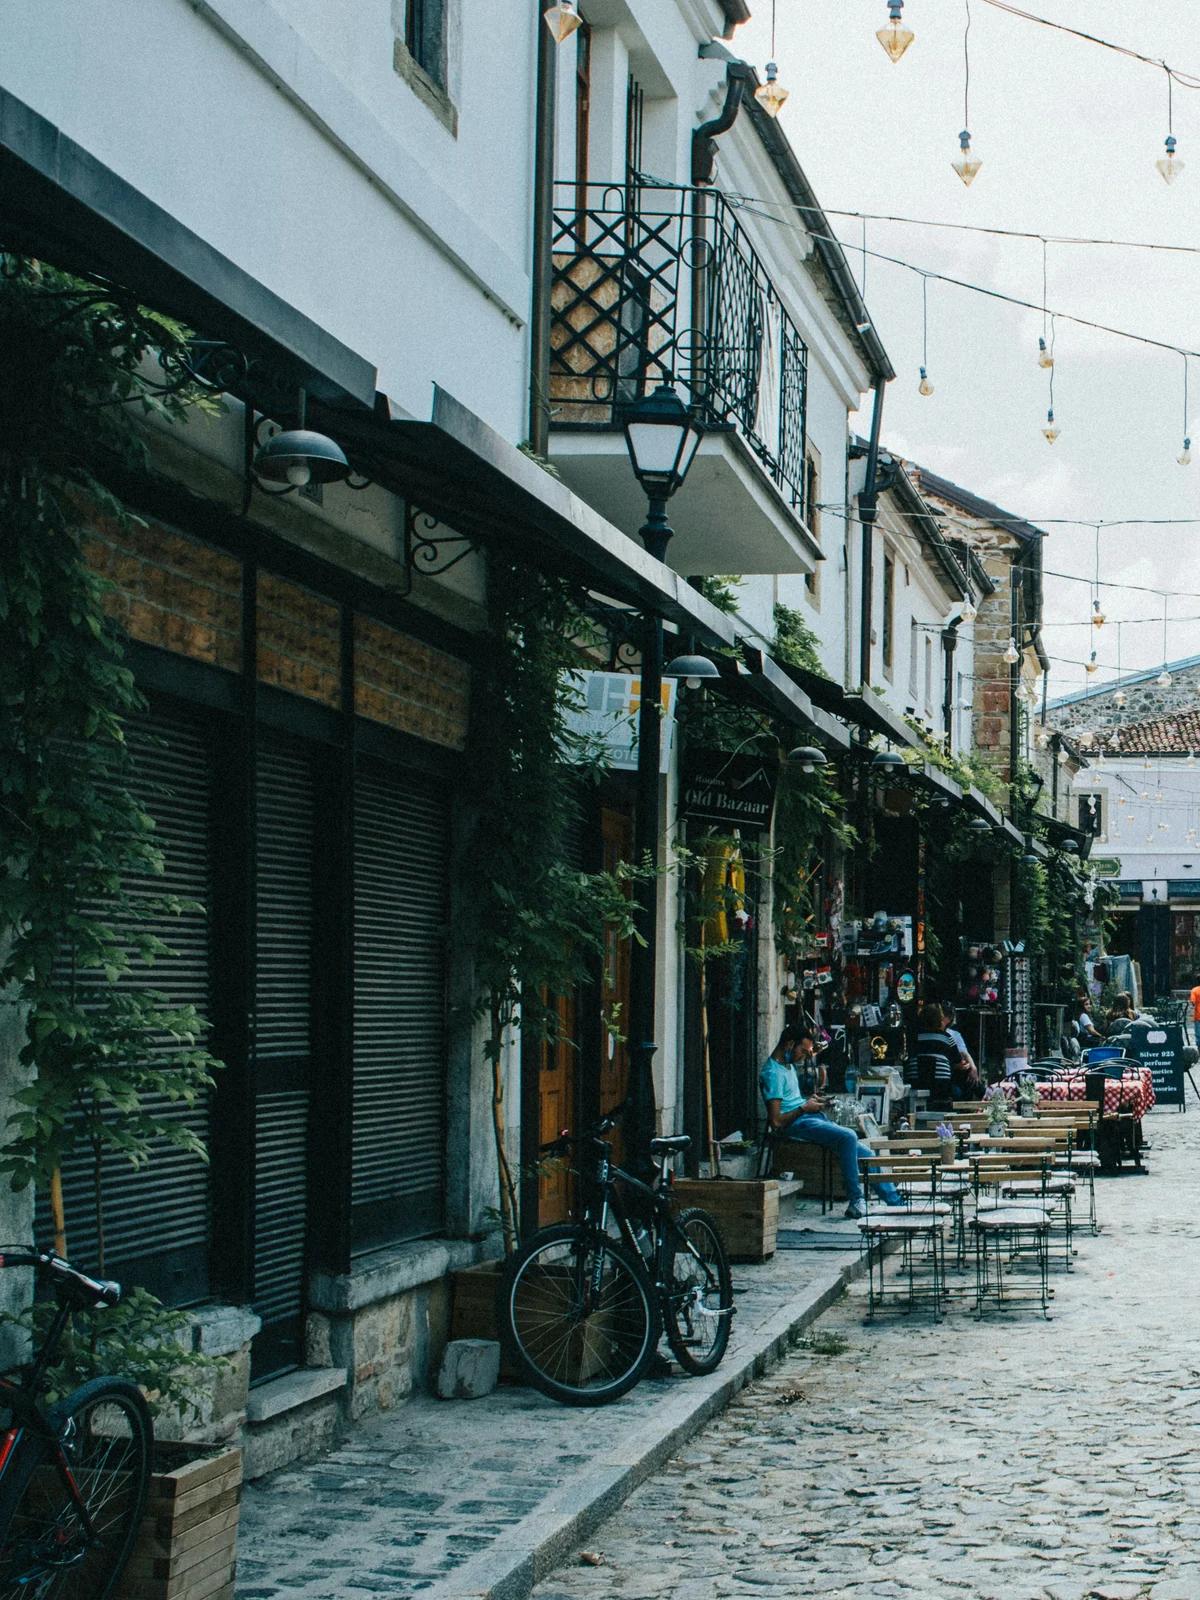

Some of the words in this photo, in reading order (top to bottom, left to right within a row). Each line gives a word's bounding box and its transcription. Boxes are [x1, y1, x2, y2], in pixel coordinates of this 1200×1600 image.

[613, 749, 639, 761] OTE
[685, 788, 712, 806] Old
[716, 793, 769, 815] Bazaar
